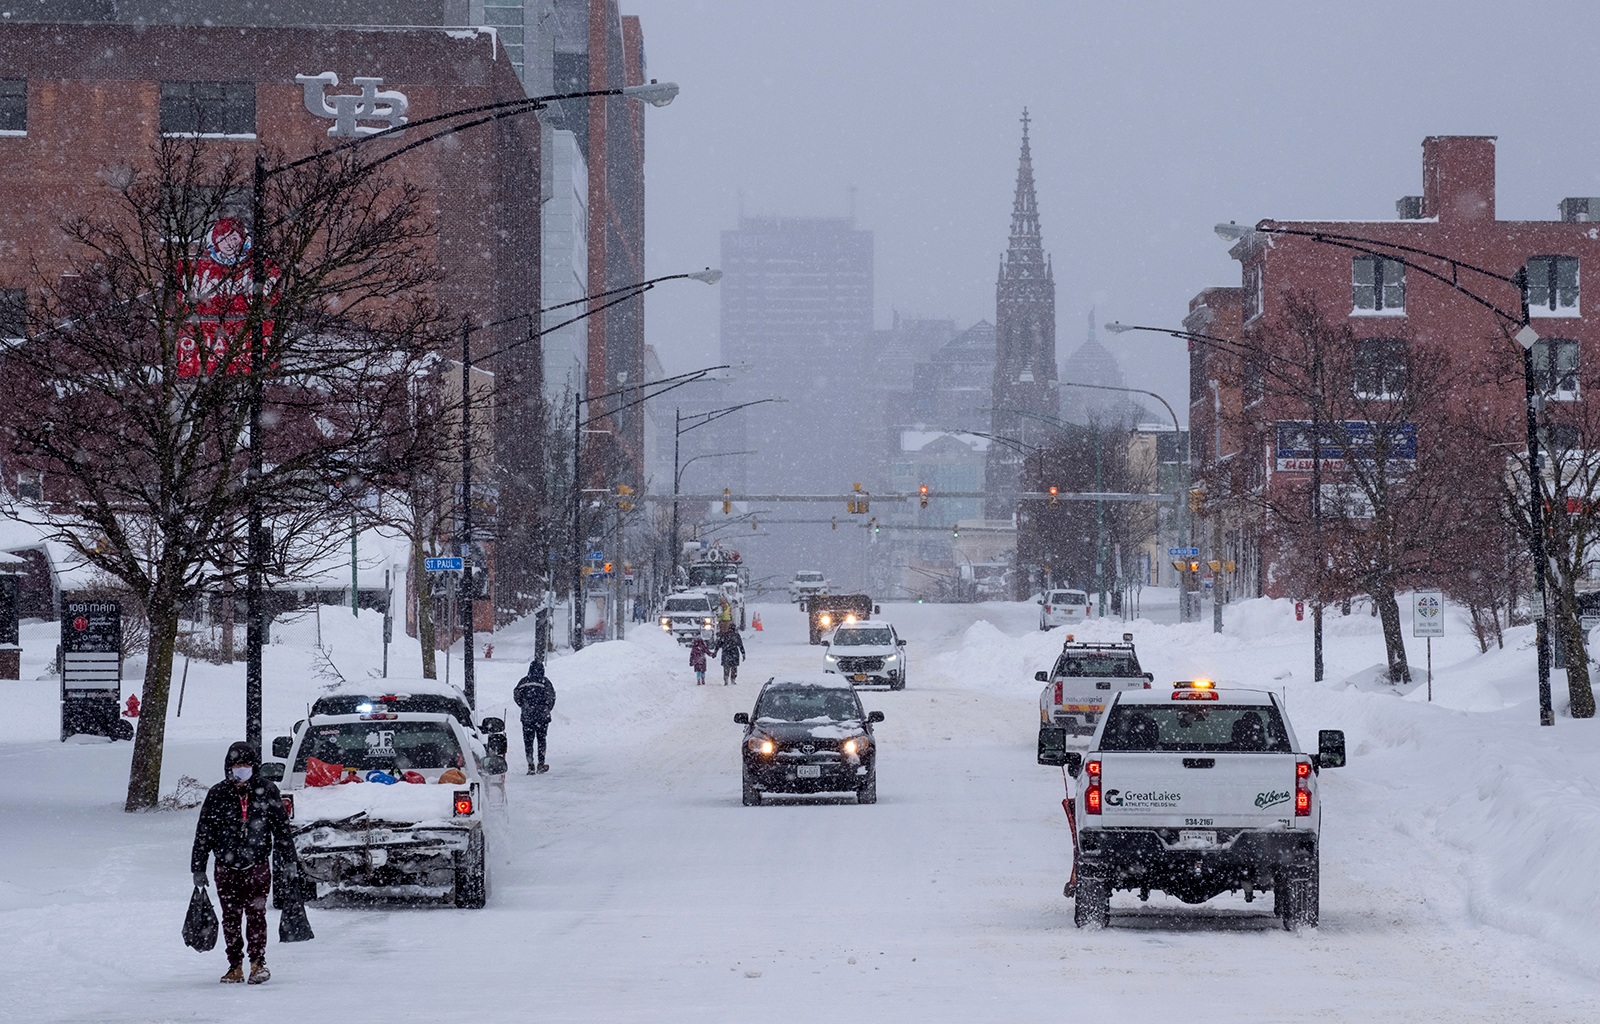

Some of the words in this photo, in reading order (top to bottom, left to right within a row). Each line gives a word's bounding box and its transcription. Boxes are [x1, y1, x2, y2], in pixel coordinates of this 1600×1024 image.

[426, 560, 436, 569] ST.
[437, 560, 454, 568] PAUL
[69, 604, 88, 612] 1091
[1125, 791, 1181, 801] GreatLakes
